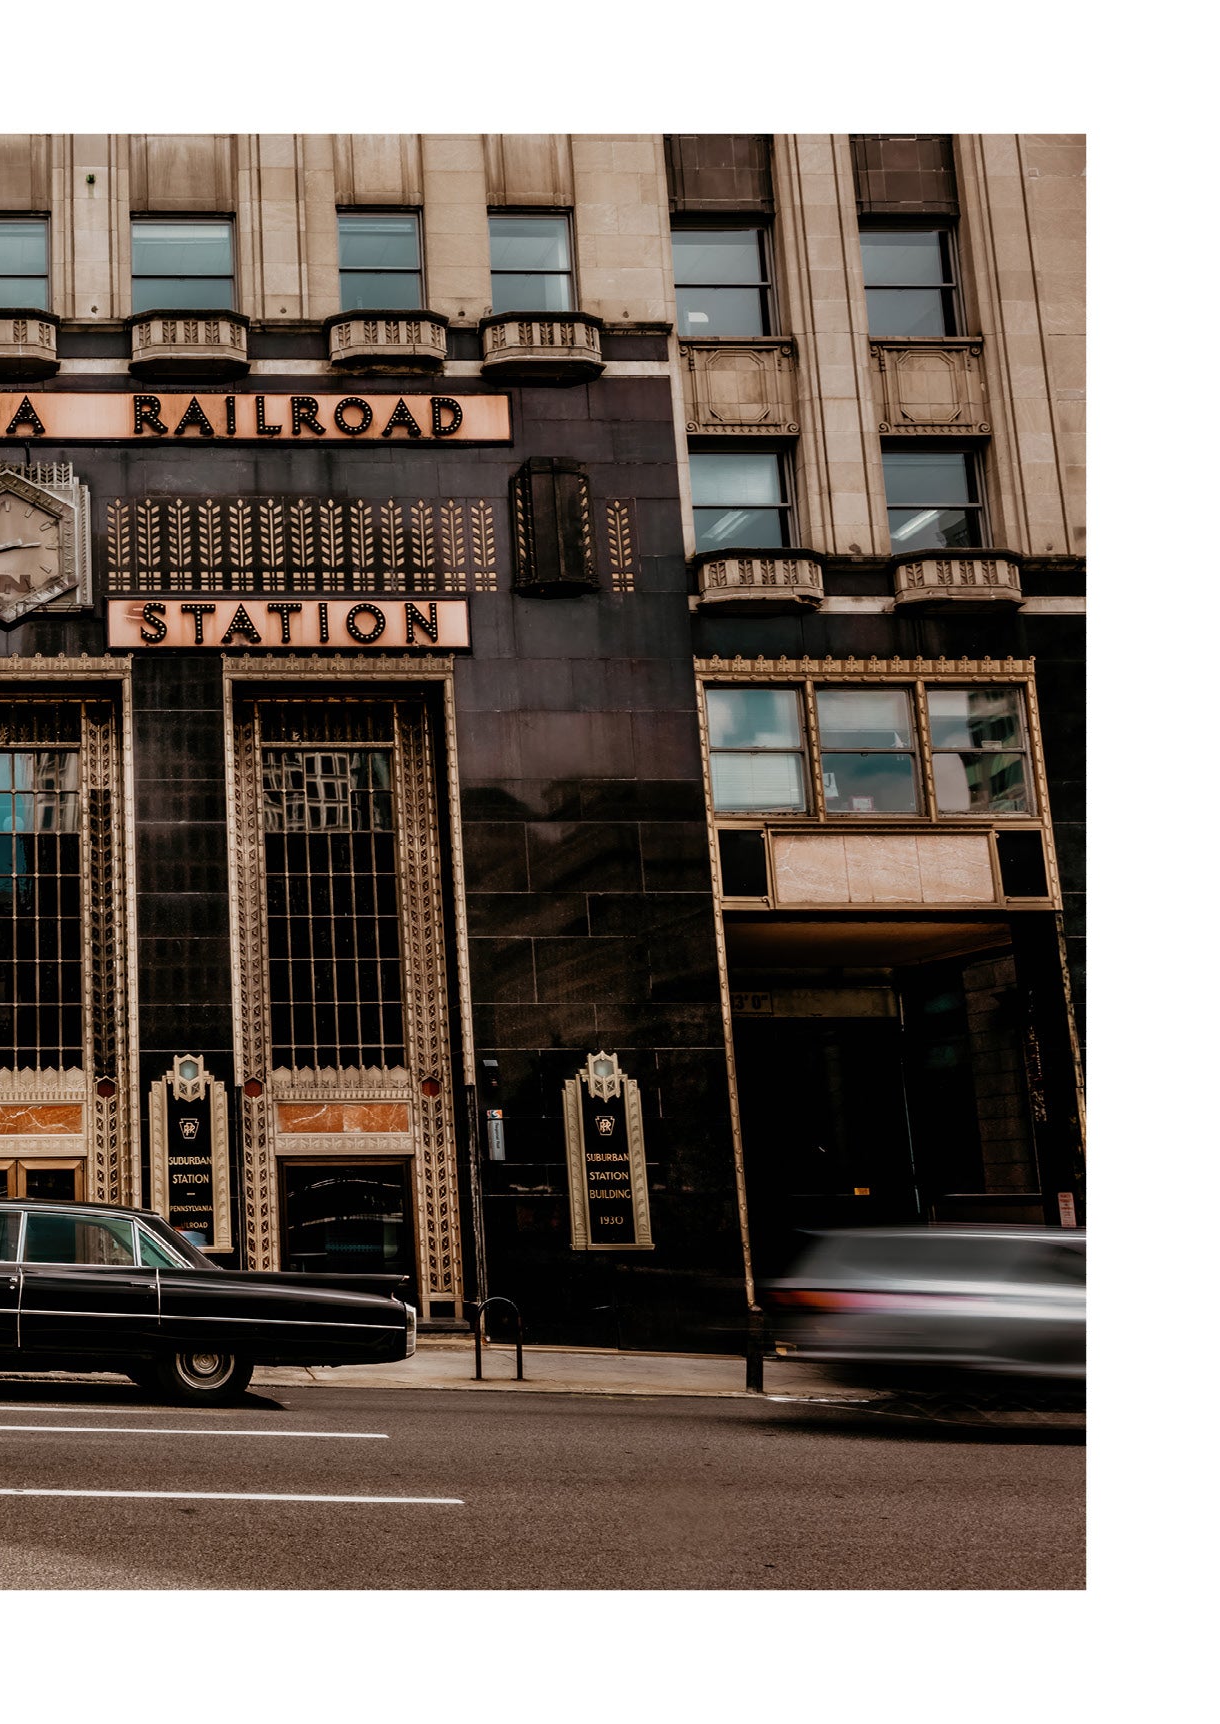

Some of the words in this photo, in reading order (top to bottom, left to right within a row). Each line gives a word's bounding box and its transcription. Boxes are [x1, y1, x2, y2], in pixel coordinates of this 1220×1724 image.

[132, 395, 464, 436] RAILROAD
[140, 602, 439, 644] STATION
[168, 1156, 212, 1166] SUBURBAN
[586, 1153, 629, 1162] SUBURBAN
[172, 1174, 209, 1184] STATION
[589, 1171, 629, 1181] STATION
[589, 1189, 631, 1199] BUILDING
[169, 1205, 213, 1213] PENNSYLVANIA
[600, 1216, 624, 1225] 1930
